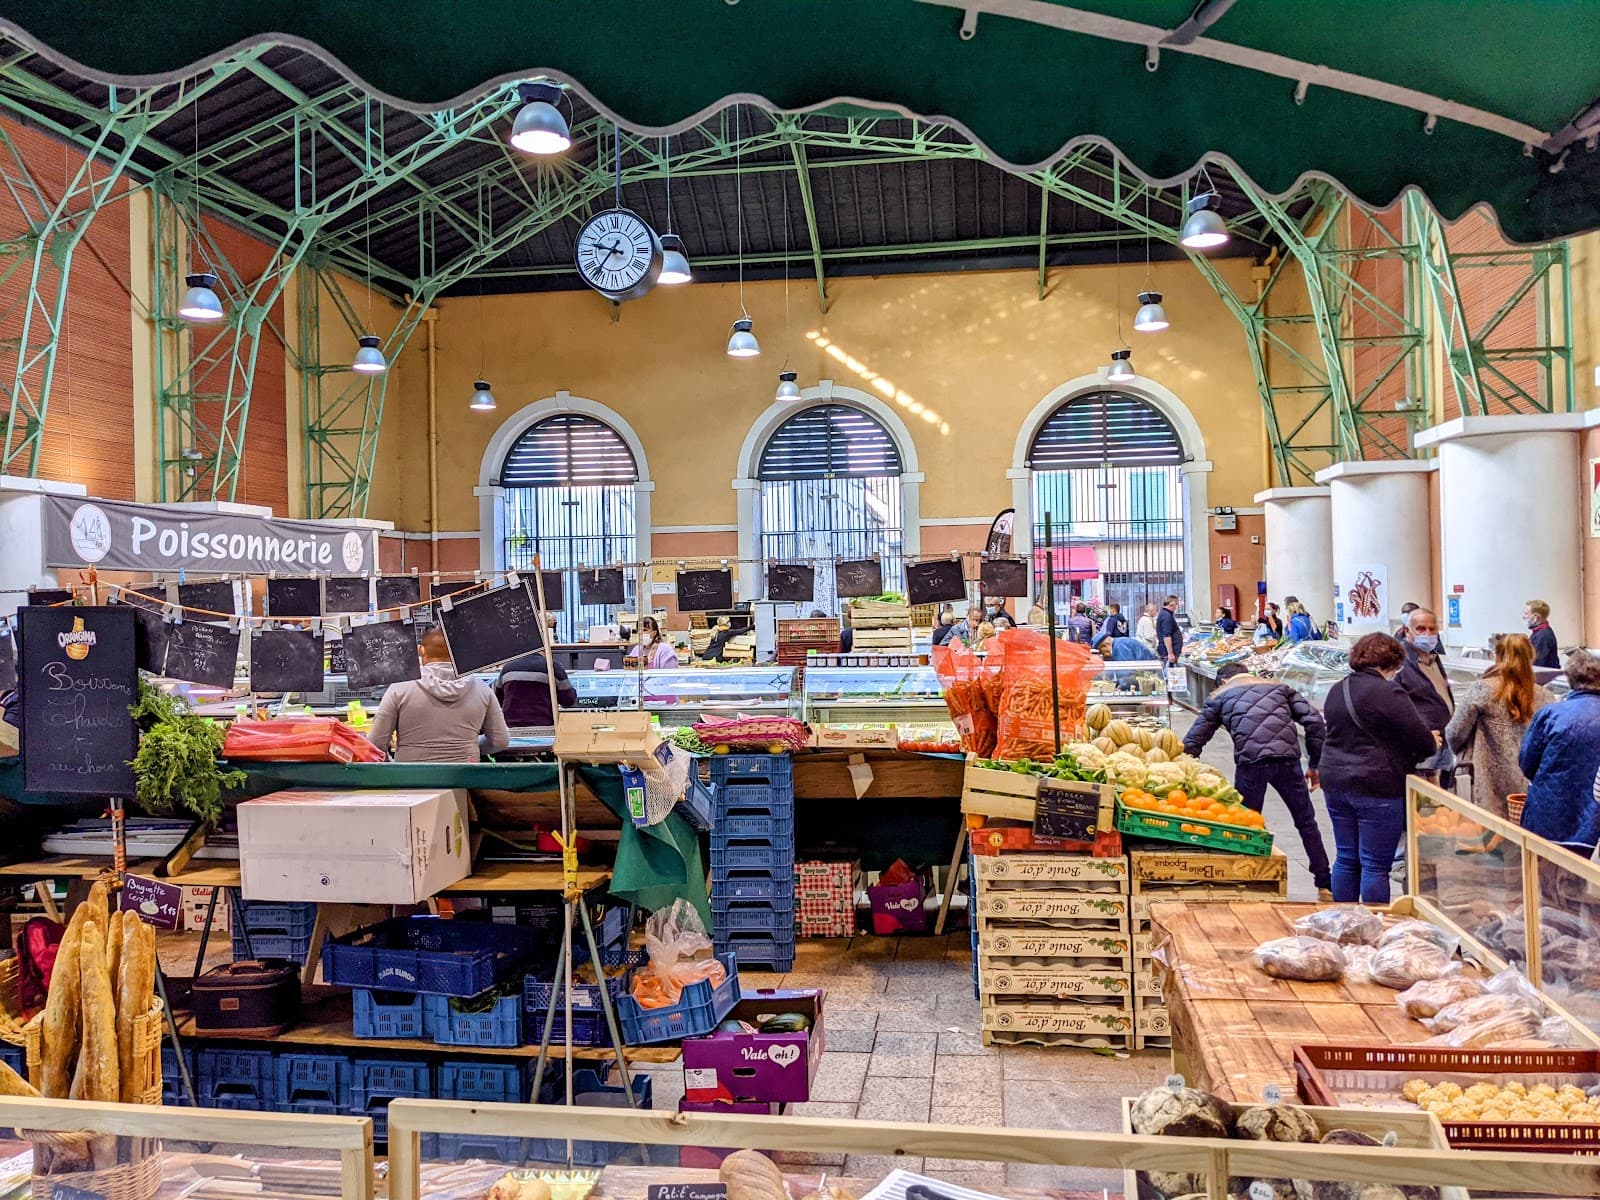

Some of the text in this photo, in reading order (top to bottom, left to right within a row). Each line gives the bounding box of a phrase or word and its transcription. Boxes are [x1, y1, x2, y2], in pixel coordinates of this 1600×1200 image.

[131, 516, 333, 565] Poissonnerie
[58, 630, 97, 648] ORANGINA
[1020, 866, 1081, 879] Boule d'or
[1019, 903, 1080, 917] Boule d'or
[1022, 942, 1083, 955] Boule d'or
[1023, 980, 1084, 994] Boule d'or
[1025, 1018, 1086, 1031] Boule d'or
[741, 1046, 768, 1060] Vale
